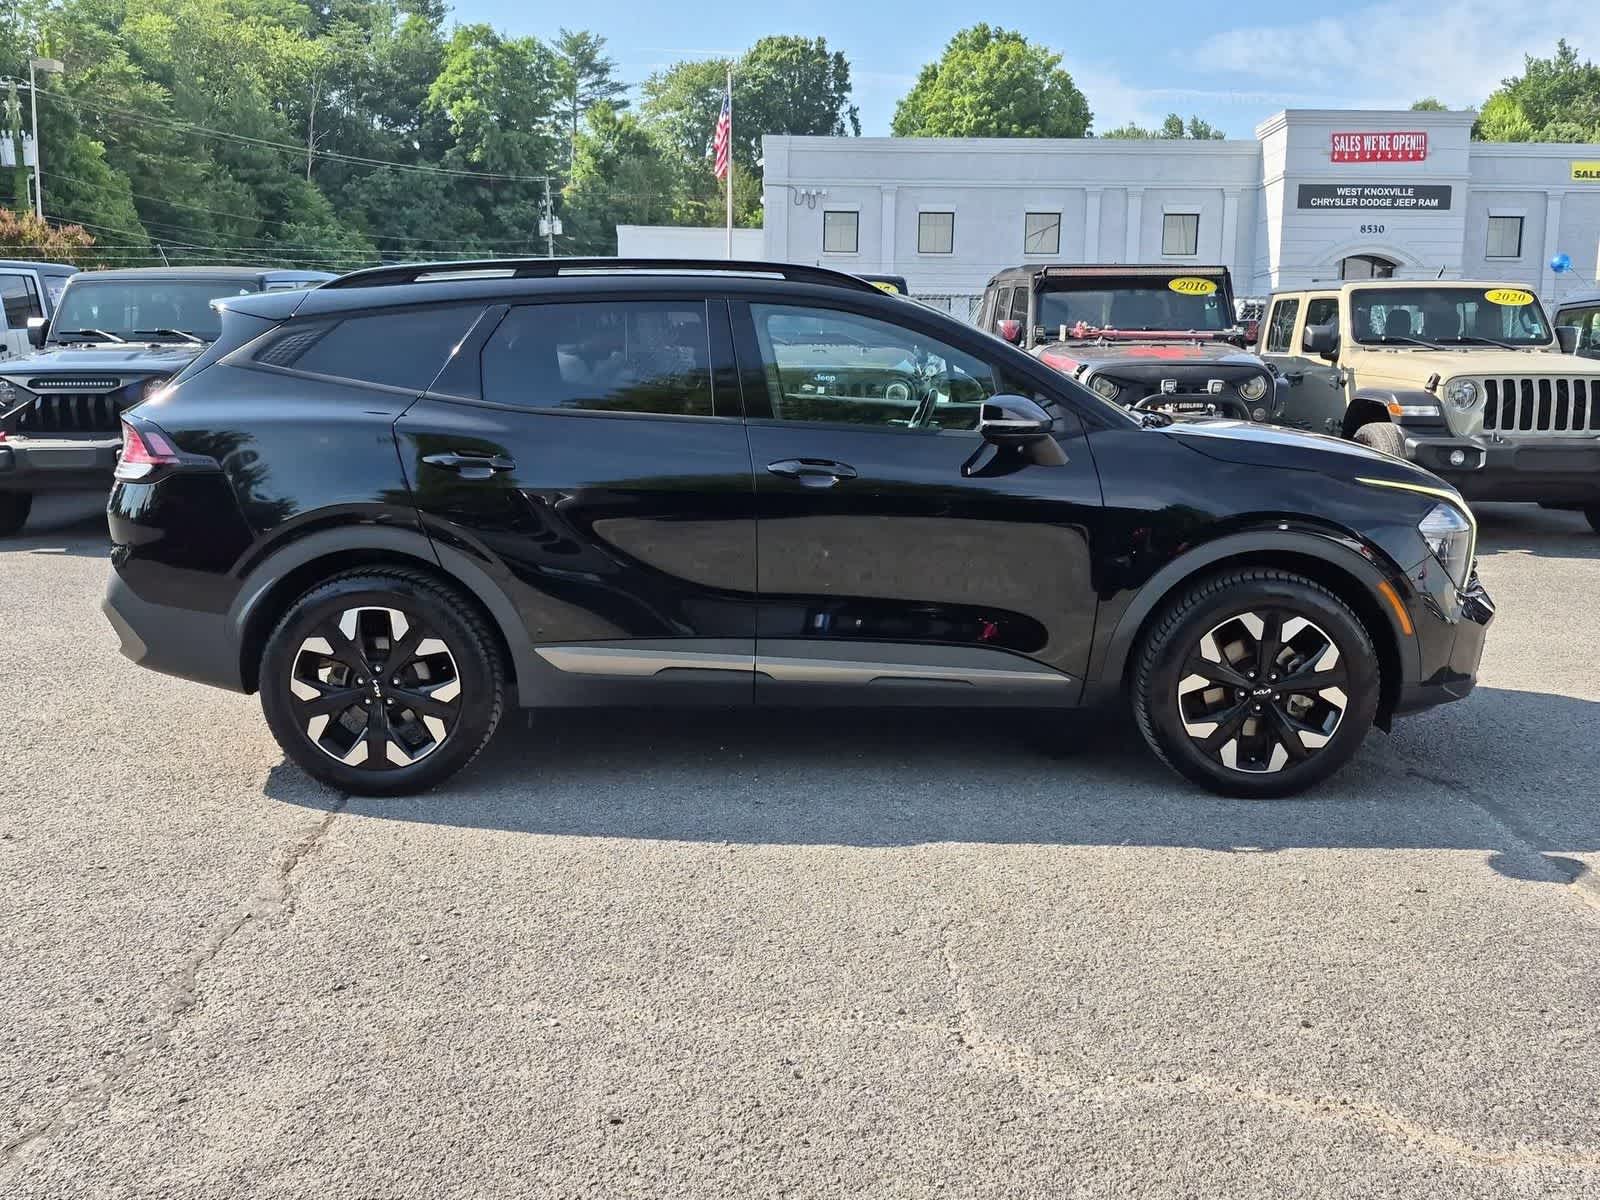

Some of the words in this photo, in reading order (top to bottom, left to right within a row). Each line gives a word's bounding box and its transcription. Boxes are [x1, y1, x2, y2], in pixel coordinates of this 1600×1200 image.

[1333, 135, 1361, 151] SALES
[1363, 135, 1391, 151] WE'RE
[1393, 134, 1425, 151] OPEN!!!
[1336, 187, 1362, 196] WEST
[1364, 187, 1414, 197] KNOXVILLE
[1310, 197, 1358, 207] CHRYSLER
[1360, 197, 1392, 207] DODGE
[1393, 198, 1416, 208] JEEP
[1418, 198, 1439, 208] RAM
[1360, 224, 1385, 234] 8530
[1178, 281, 1207, 292] 2016
[1494, 293, 1525, 303] 2020
